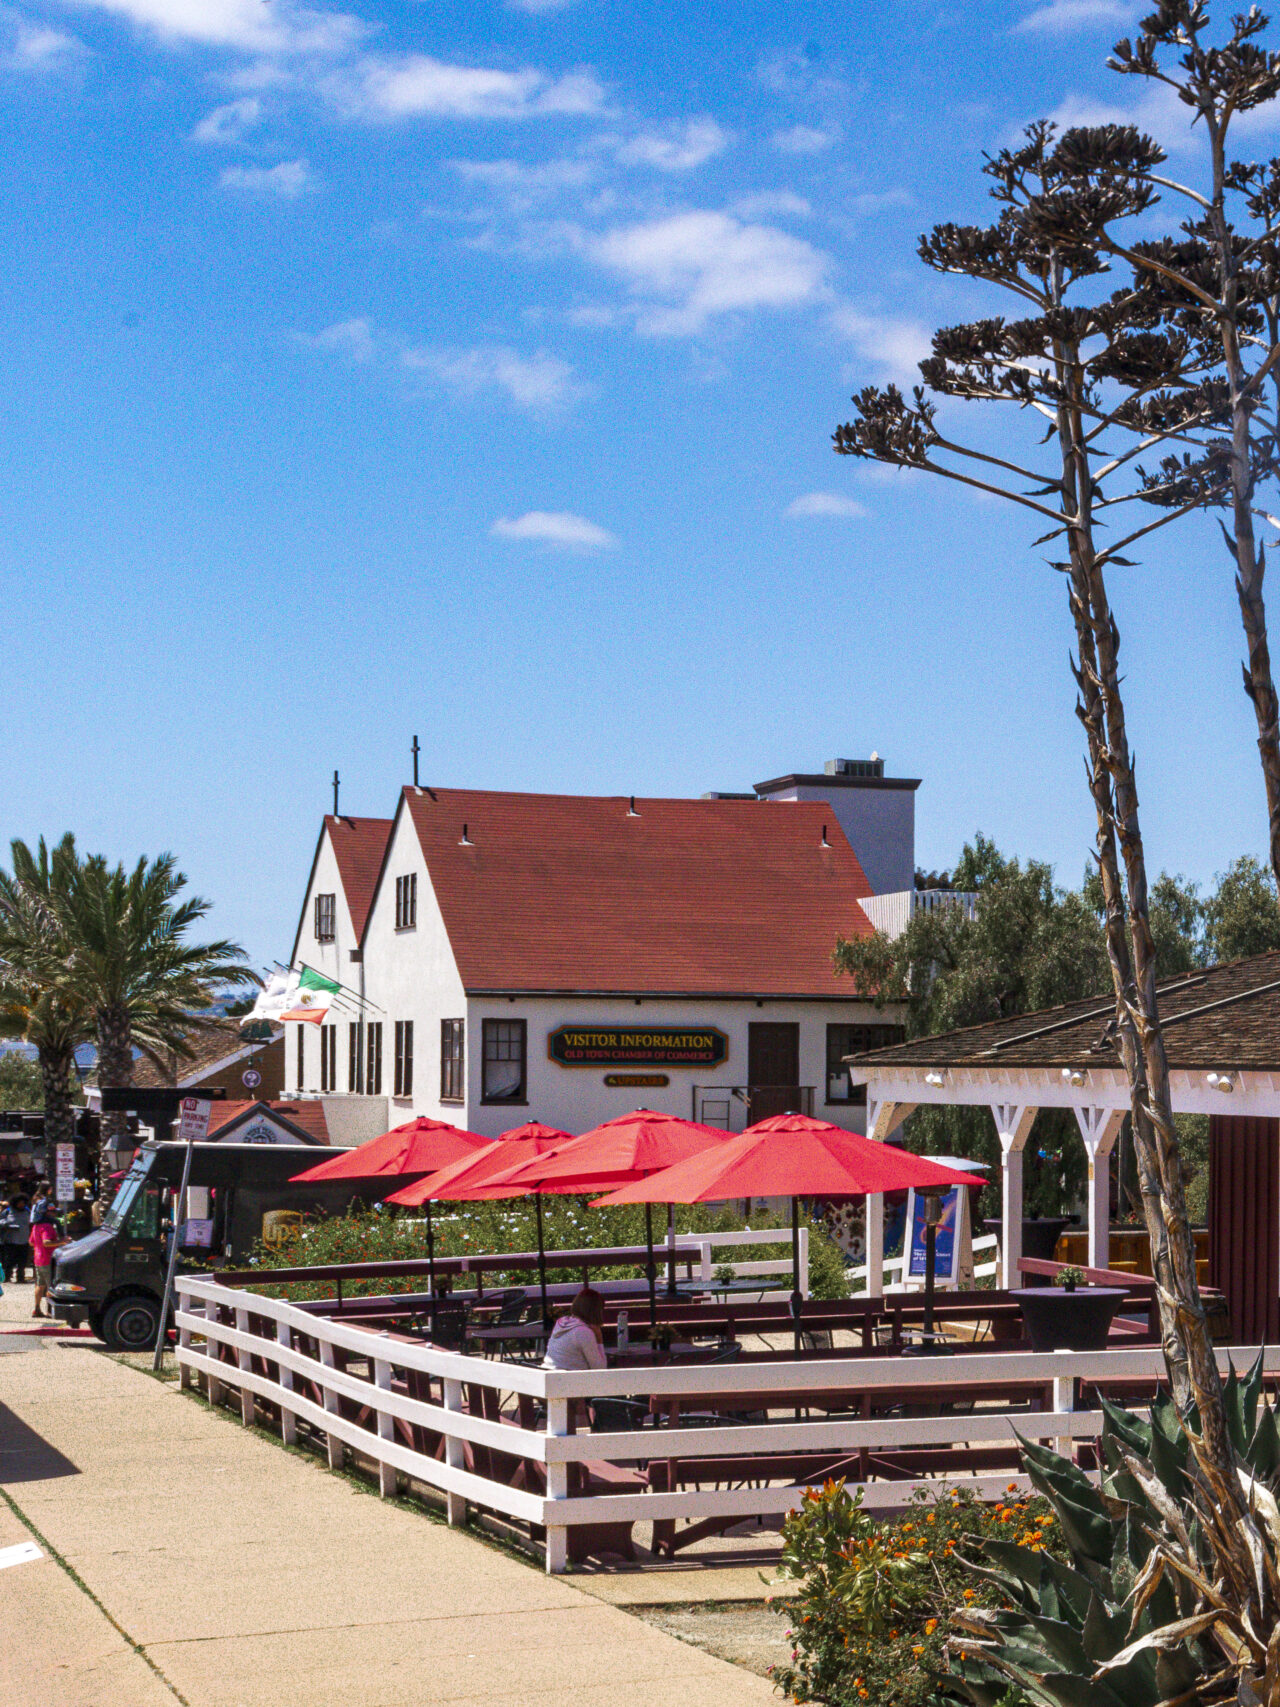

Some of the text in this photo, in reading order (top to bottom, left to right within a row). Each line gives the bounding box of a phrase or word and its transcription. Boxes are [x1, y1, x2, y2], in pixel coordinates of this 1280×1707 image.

[564, 1033, 713, 1049] VISITOR INFORMATION
[564, 1049, 584, 1059] OLD
[185, 1099, 197, 1110] NO
[183, 1112, 209, 1123] PARKING
